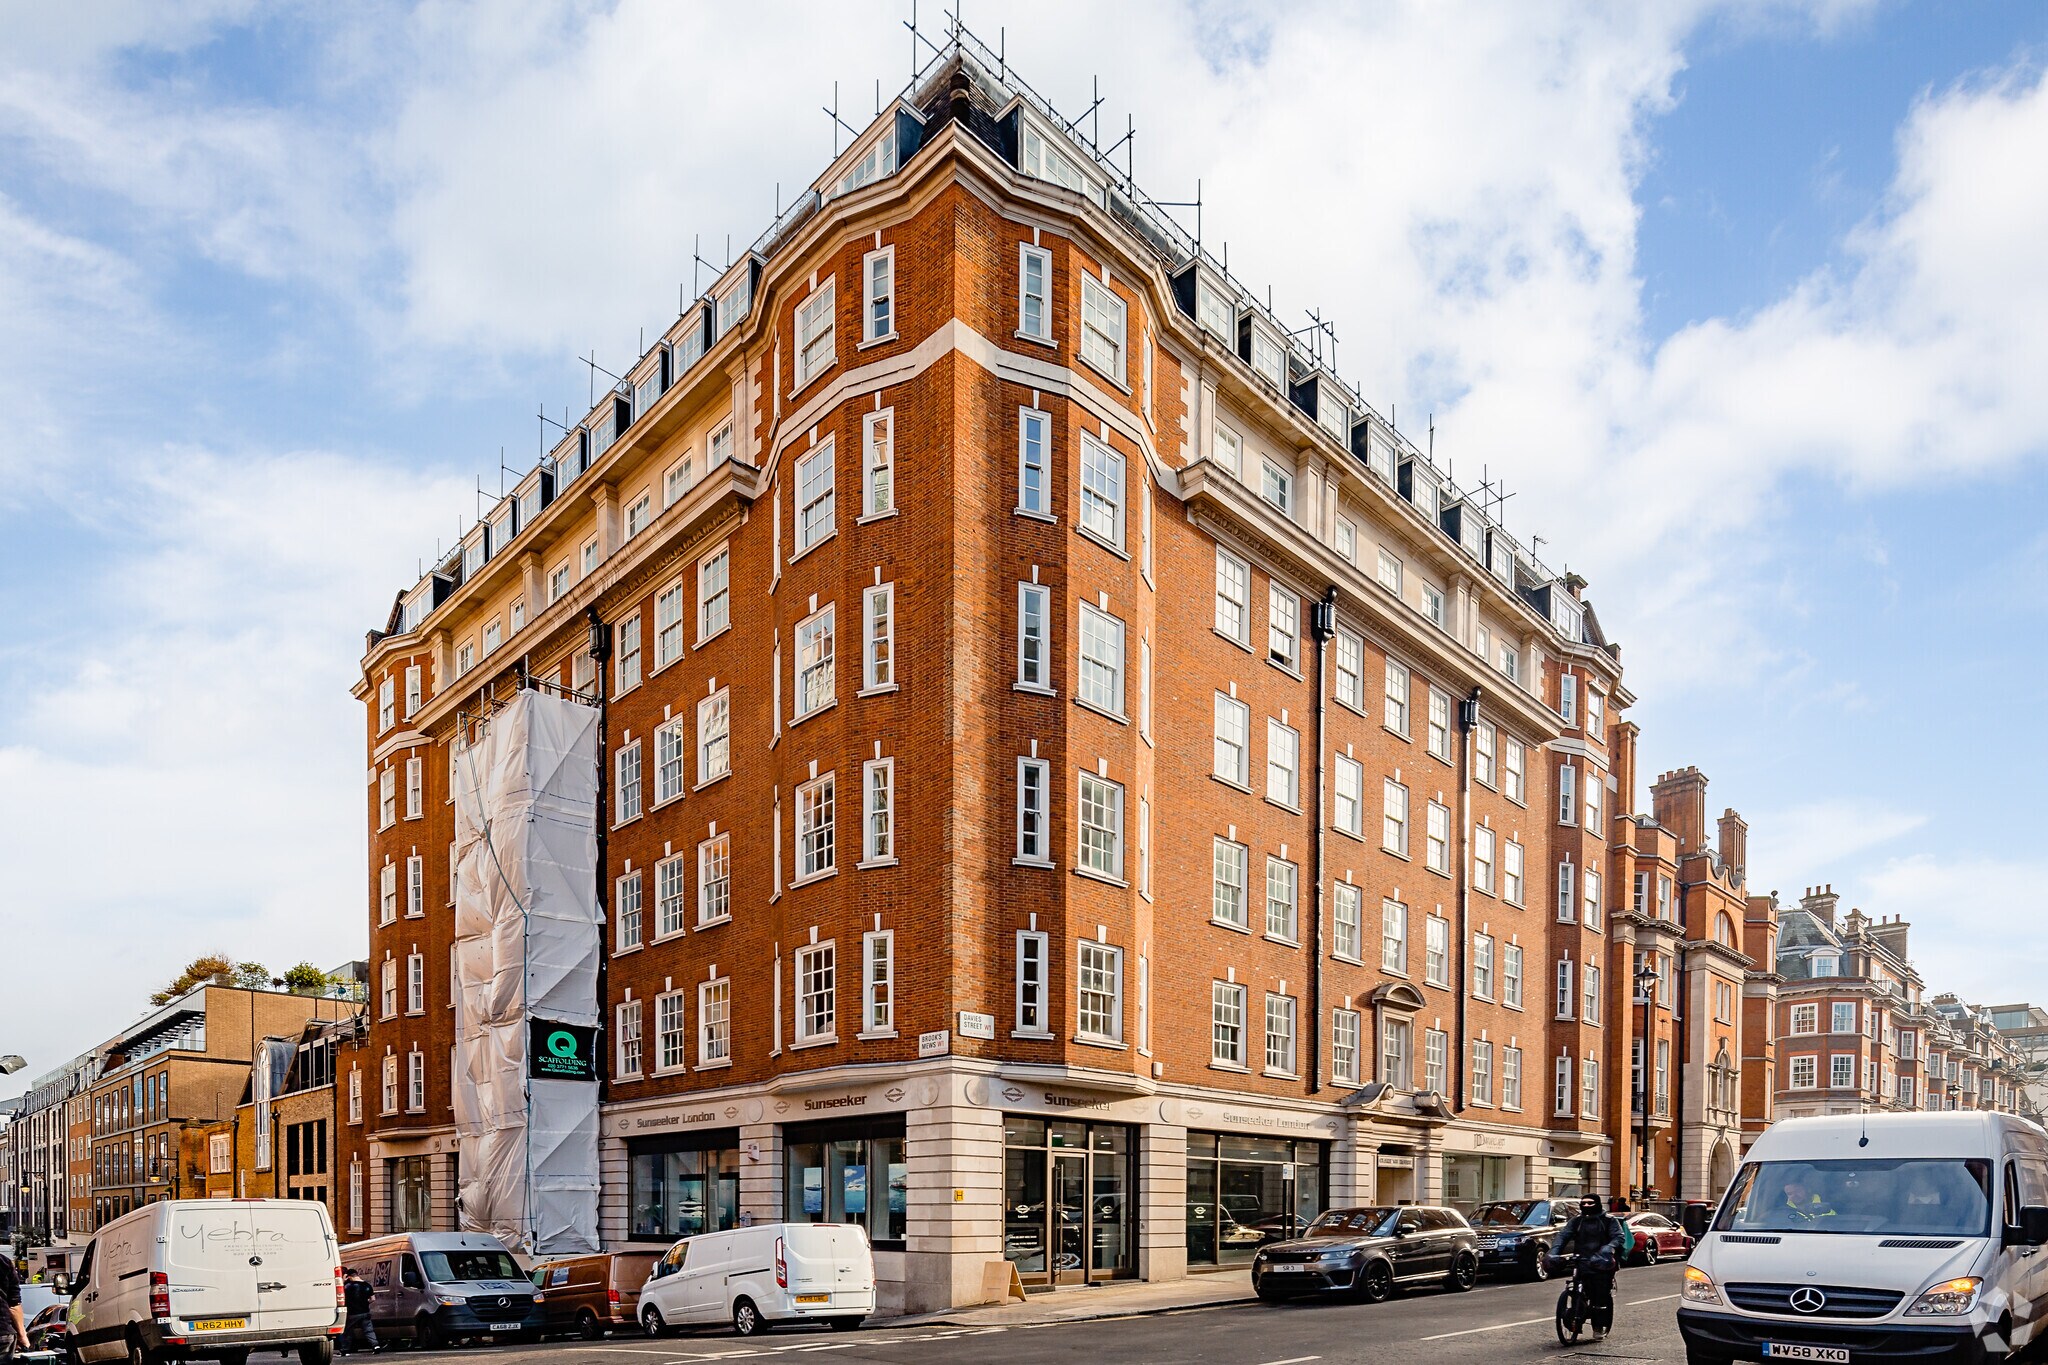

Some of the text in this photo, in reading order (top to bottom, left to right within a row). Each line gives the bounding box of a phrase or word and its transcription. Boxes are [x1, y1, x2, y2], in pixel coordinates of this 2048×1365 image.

[963, 1014, 982, 1022] DAVIES
[963, 1021, 983, 1030] STREET
[921, 1033, 942, 1042] BROOK'S
[547, 1031, 577, 1059] Q
[921, 1041, 937, 1050] MEWS
[538, 1056, 587, 1067] SCAFFOLDING
[804, 1095, 867, 1111] Sunseeker
[1044, 1092, 1113, 1111] Sunseeker
[637, 1116, 680, 1128] Sunseeker
[682, 1111, 716, 1124] London
[1223, 1112, 1273, 1126] Sunseeker
[1276, 1117, 1311, 1130] London
[196, 1320, 243, 1330] LR62 HHY
[1772, 1345, 1847, 1361] WV58 XKO
